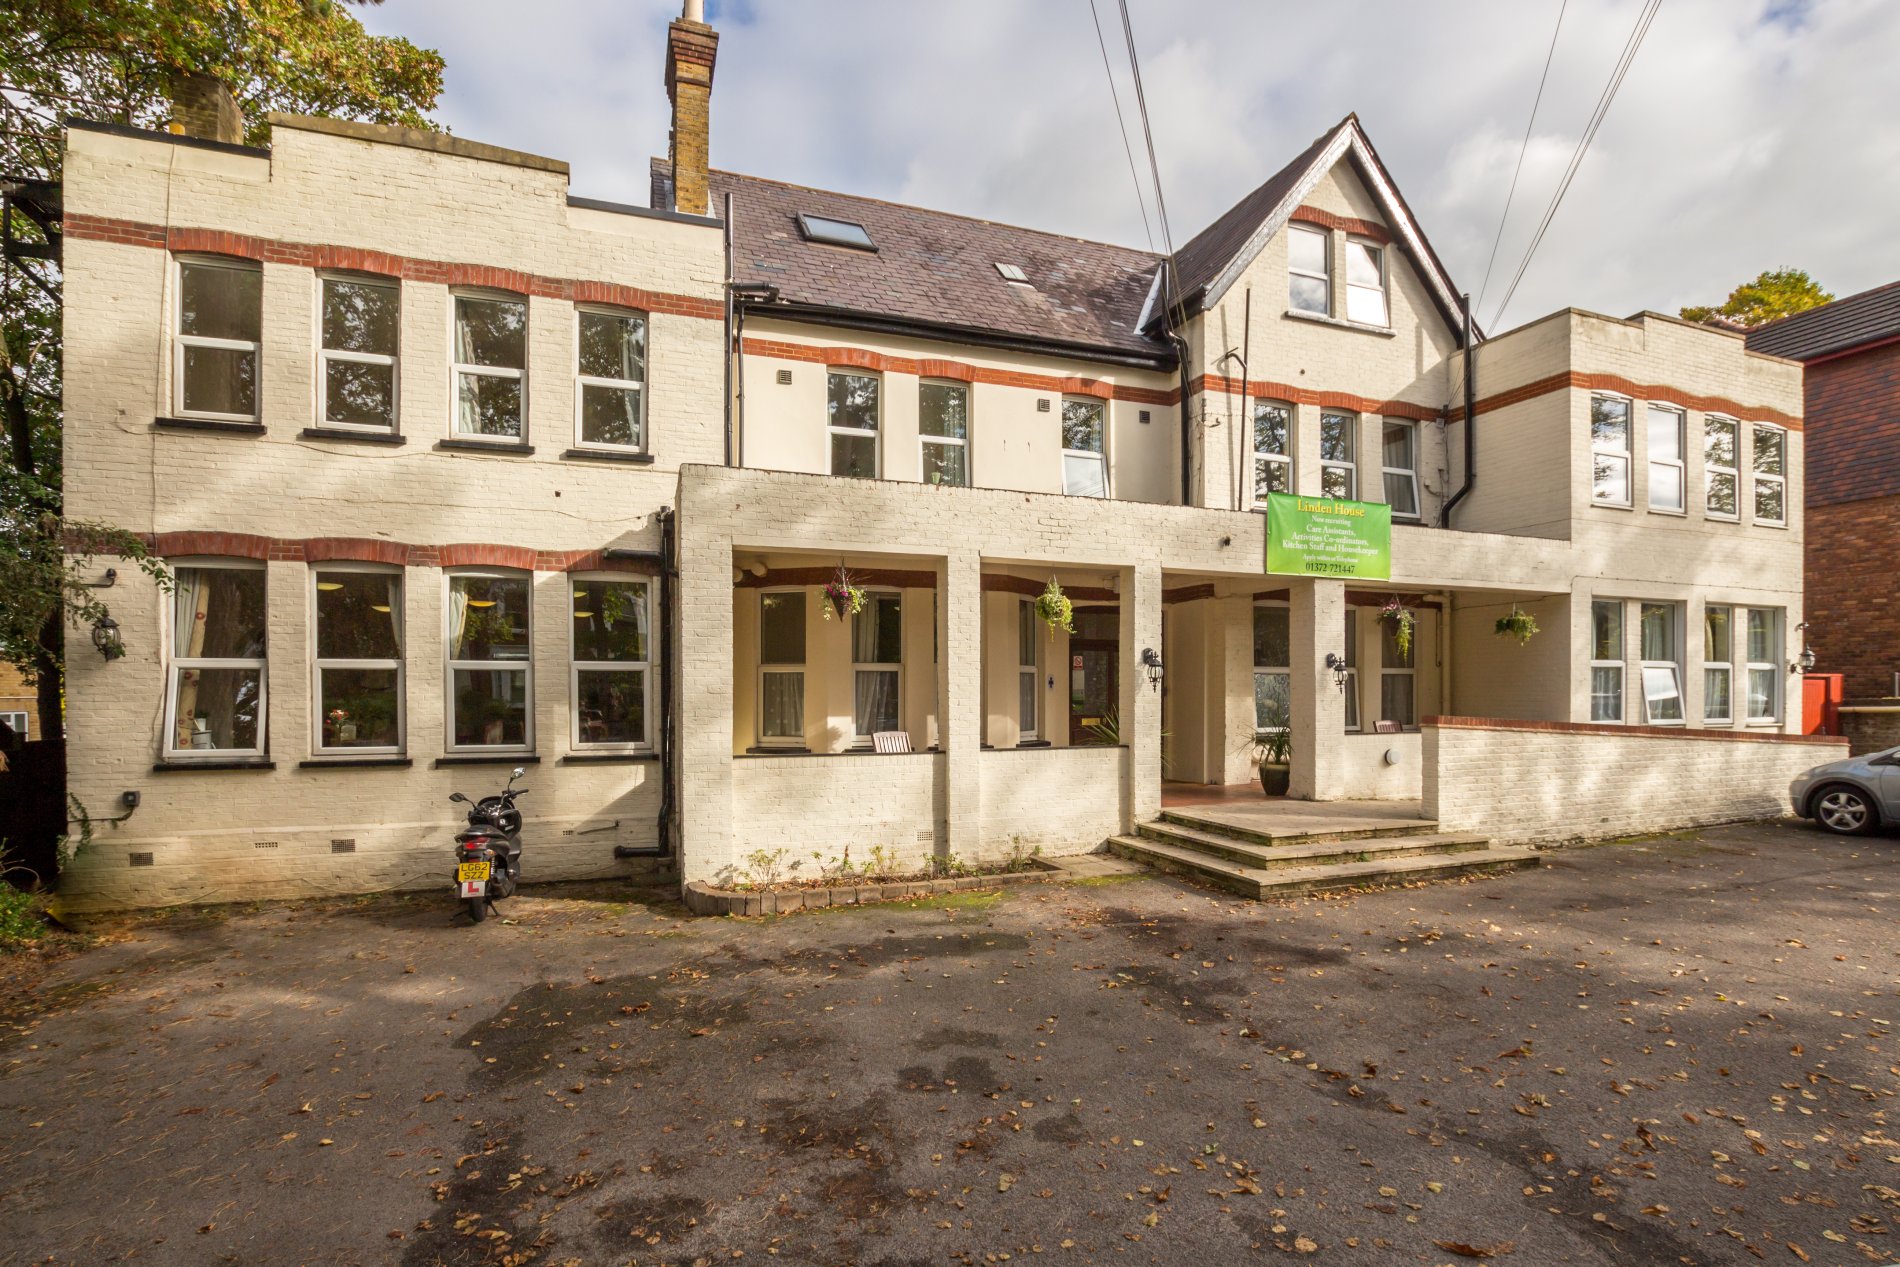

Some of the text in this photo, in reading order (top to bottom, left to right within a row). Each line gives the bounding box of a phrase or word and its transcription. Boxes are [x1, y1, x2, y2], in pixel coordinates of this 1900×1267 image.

[1297, 499, 1365, 517] Linden House
[1312, 515, 1351, 527] Now recruiting
[1306, 523, 1356, 537] Care Assistants,
[1292, 531, 1369, 546] Activities Co-ordinators,
[1283, 539, 1378, 556] Kitchen Staff and Housekeeper
[1306, 562, 1355, 573] 01372 721447
[464, 871, 483, 879] SZZ
[468, 882, 479, 892] L
